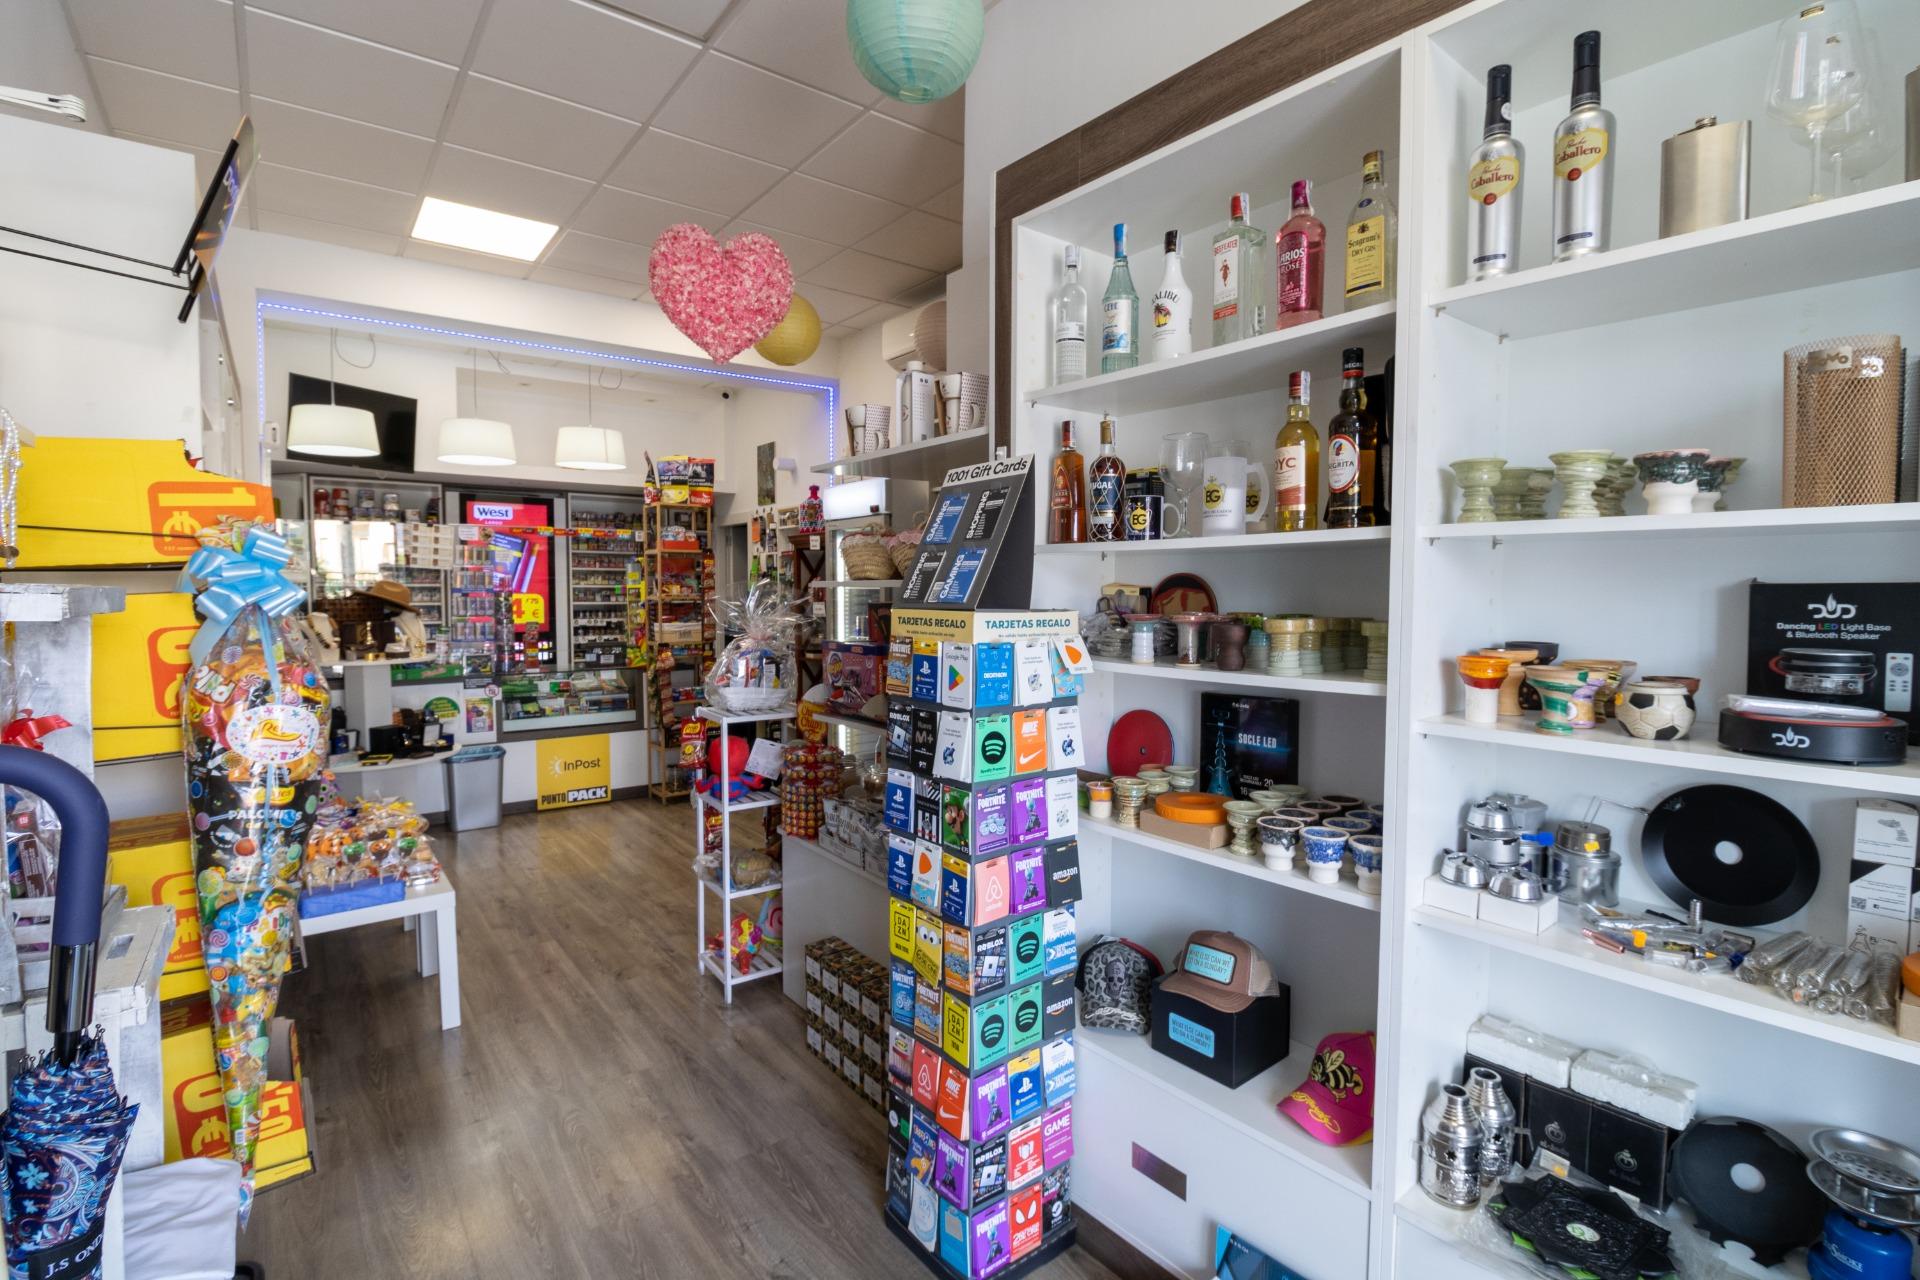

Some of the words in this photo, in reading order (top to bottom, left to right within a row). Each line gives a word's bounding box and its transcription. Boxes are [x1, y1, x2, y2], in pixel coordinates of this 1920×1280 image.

[1555, 143, 1601, 166] Caballero
[1470, 171, 1514, 189] Caballero
[1347, 232, 1381, 249] Seagram's
[947, 469, 970, 483] 1001
[970, 464, 992, 479] Gift
[993, 458, 1028, 475] Cards
[477, 506, 509, 518] West
[926, 500, 951, 541] GAMING
[966, 490, 990, 539] SHOPPING
[903, 552, 928, 599] SHOPPING
[940, 554, 965, 599] GAMING
[897, 616, 933, 627] TARJETAS
[935, 619, 966, 629] REGALO
[985, 619, 1034, 630] TARJETAS
[1036, 618, 1071, 628] REGALO
[1776, 622, 1816, 632] Dancing
[1818, 623, 1839, 631] LED
[1841, 623, 1864, 632] Light
[1786, 631, 1793, 639] &
[1795, 631, 1838, 639] Bluetooth
[1840, 632, 1881, 640] Speaker
[1238, 733, 1262, 746] SOCLE
[1263, 736, 1277, 749] LED
[563, 757, 601, 772] InPost
[541, 792, 567, 805] PUNTO
[568, 787, 607, 802] PACK
[978, 793, 1006, 810] FORTNITE
[1015, 786, 1044, 803] FORTNITE
[1015, 855, 1042, 873] FORTNITE
[1052, 866, 1078, 881] amazon
[977, 938, 1004, 952] ROBLOX
[1046, 996, 1073, 1014] amazon
[977, 1074, 1007, 1100] FORTNITE
[1044, 1114, 1071, 1137] GAME
[975, 1146, 1003, 1165] ROBLOX
[976, 1209, 1007, 1238] FORTNITE
